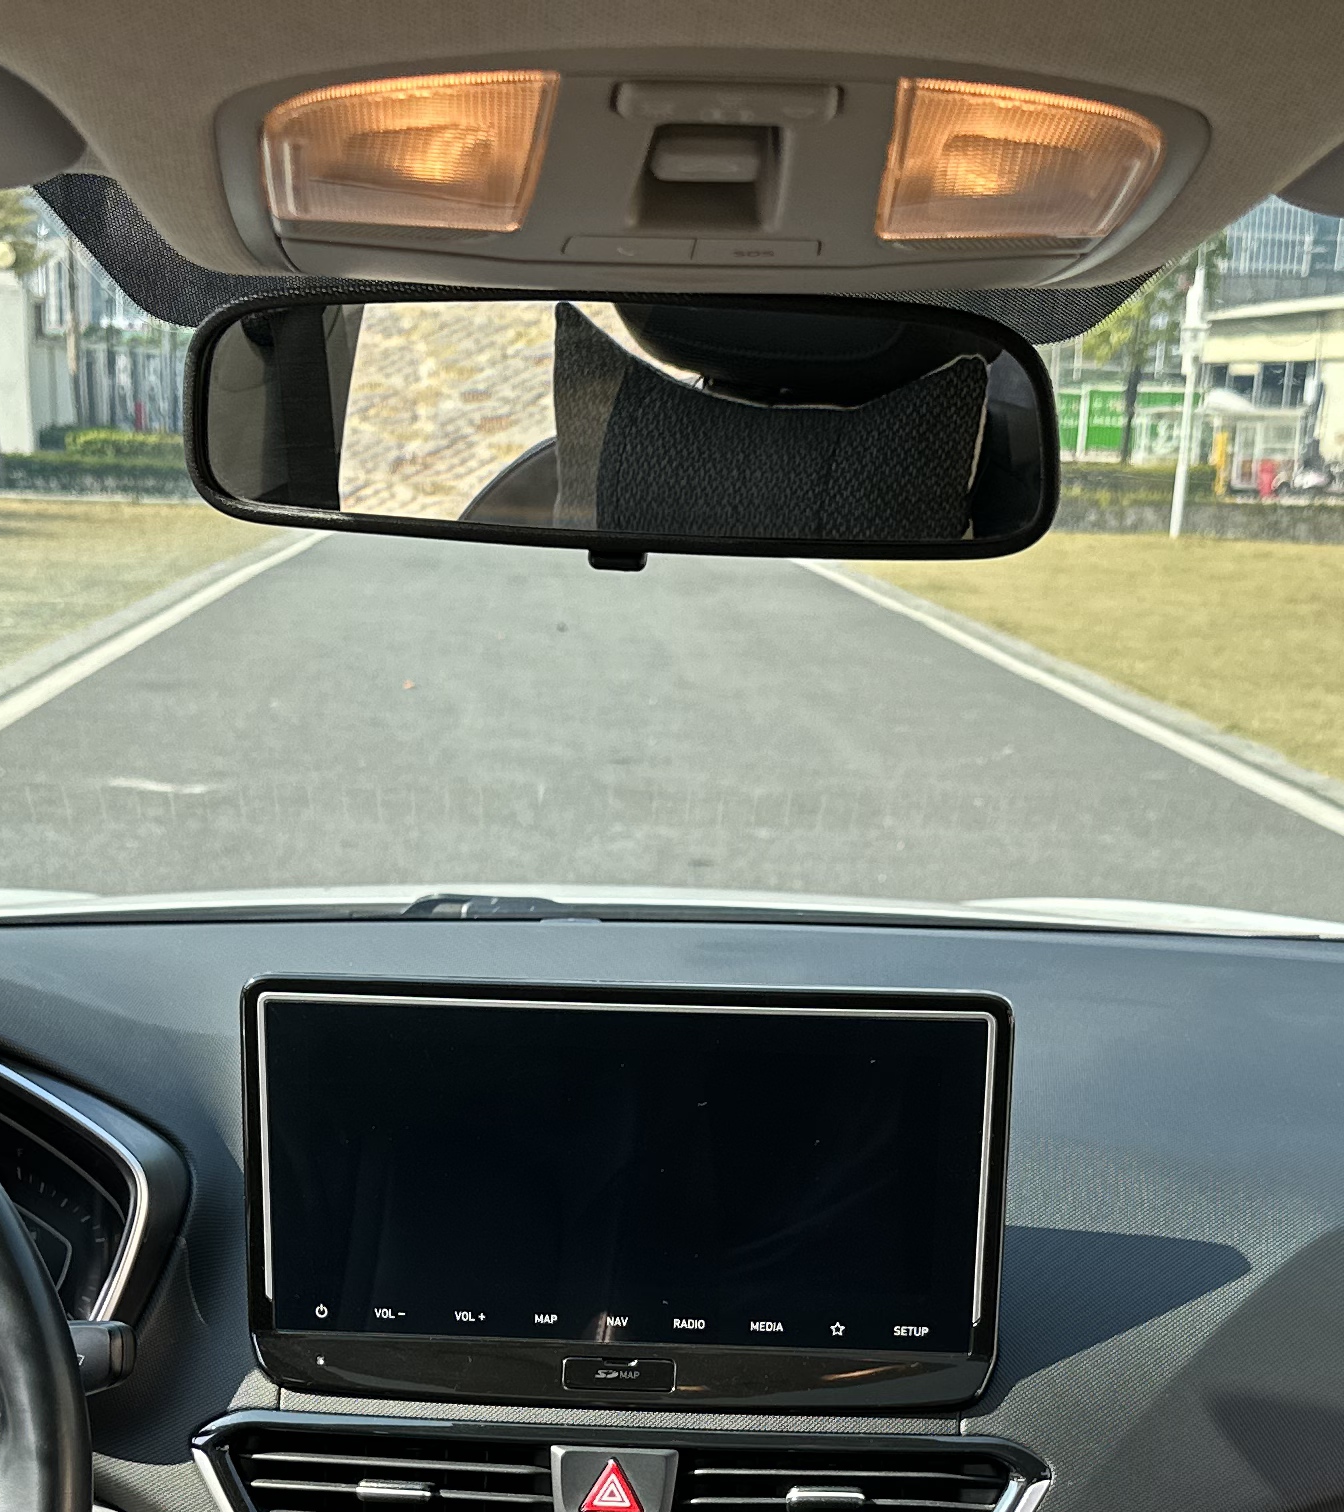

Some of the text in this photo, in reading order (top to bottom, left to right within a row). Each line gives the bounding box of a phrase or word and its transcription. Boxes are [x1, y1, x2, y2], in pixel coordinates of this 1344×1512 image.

[374, 1307, 395, 1319] VOL
[454, 1310, 475, 1322] VOL
[534, 1313, 558, 1325] MAP
[606, 1316, 629, 1327] NAV
[673, 1318, 706, 1330] RADIO
[750, 1321, 784, 1333] MEDIA
[893, 1325, 929, 1337] SETUP
[619, 1370, 641, 1379] MAP
